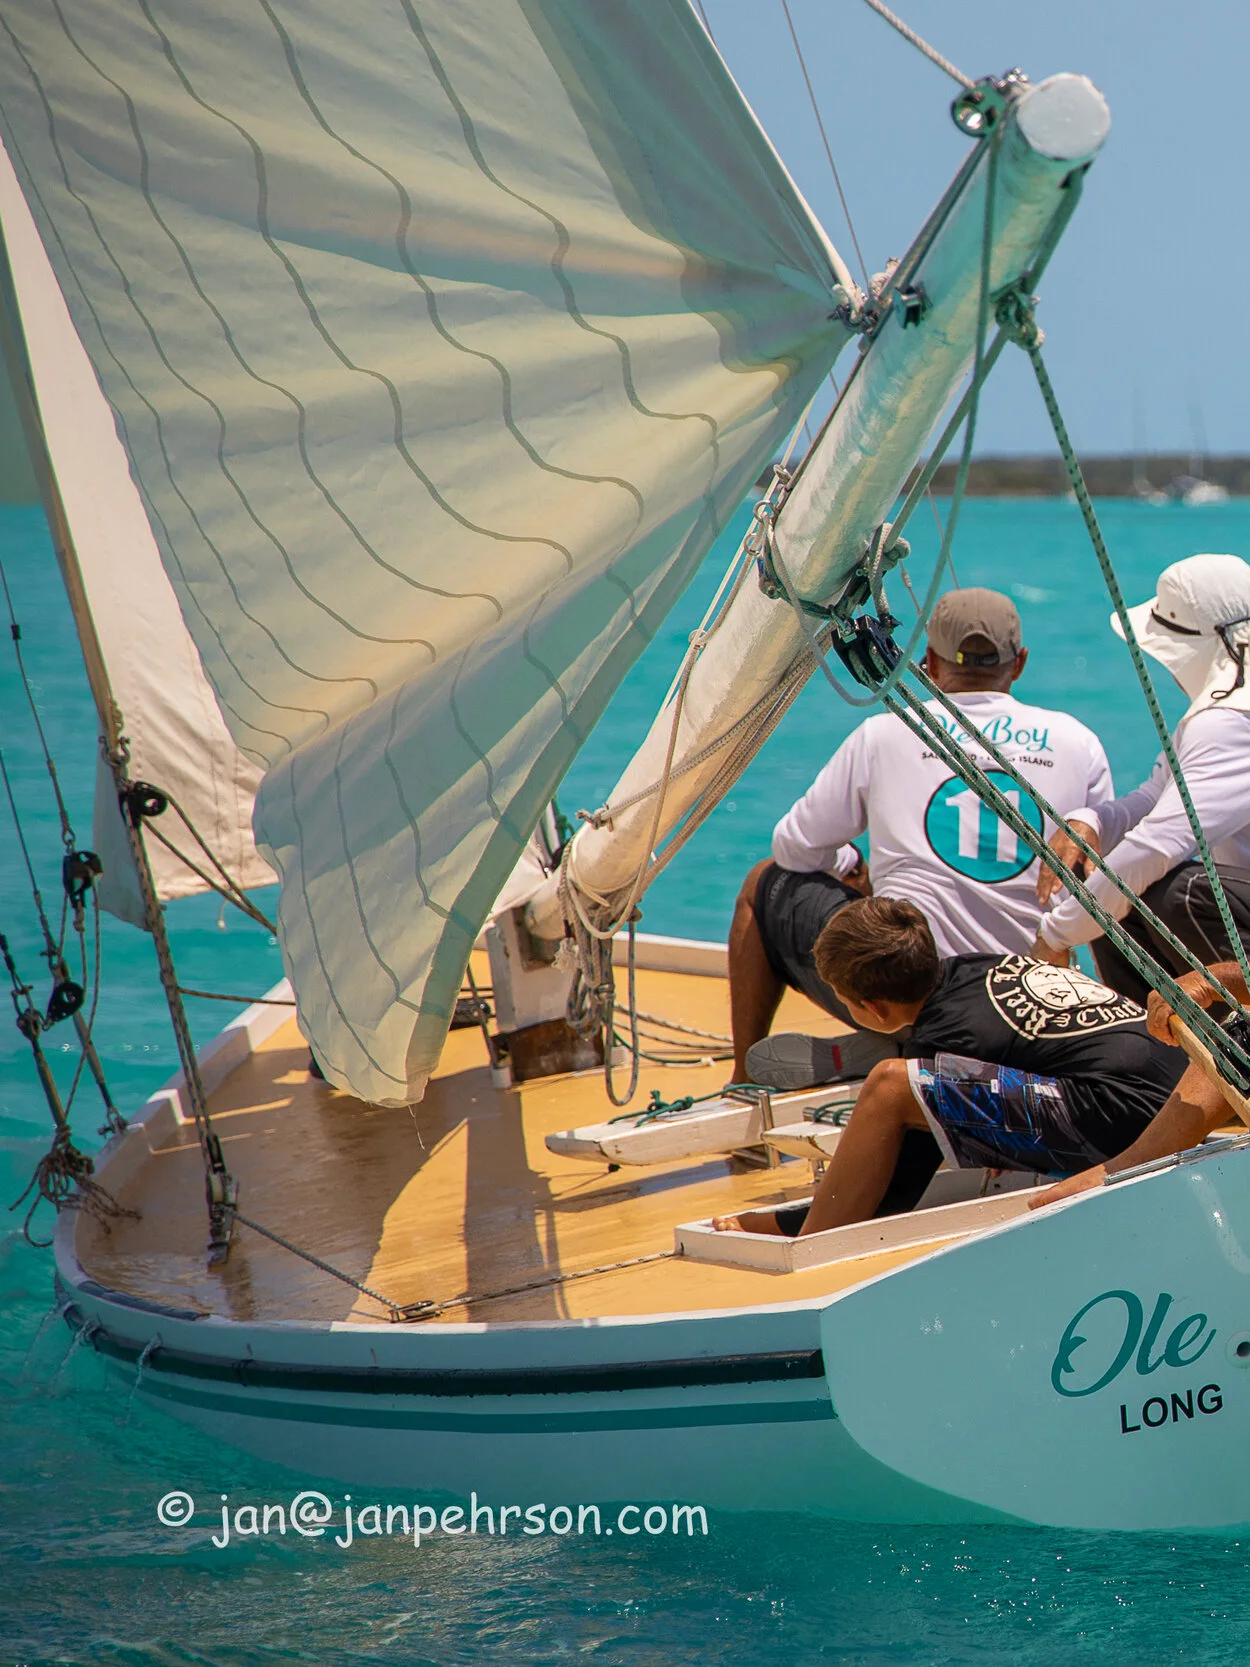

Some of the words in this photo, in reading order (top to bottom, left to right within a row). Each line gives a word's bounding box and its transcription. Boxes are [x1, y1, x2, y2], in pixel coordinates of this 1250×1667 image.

[982, 714, 1053, 752] Boy
[1019, 756, 1054, 768] ISLAND
[945, 788, 1020, 864] 11
[1051, 1289, 1217, 1397] Ole
[1119, 1383, 1225, 1434] LONG
